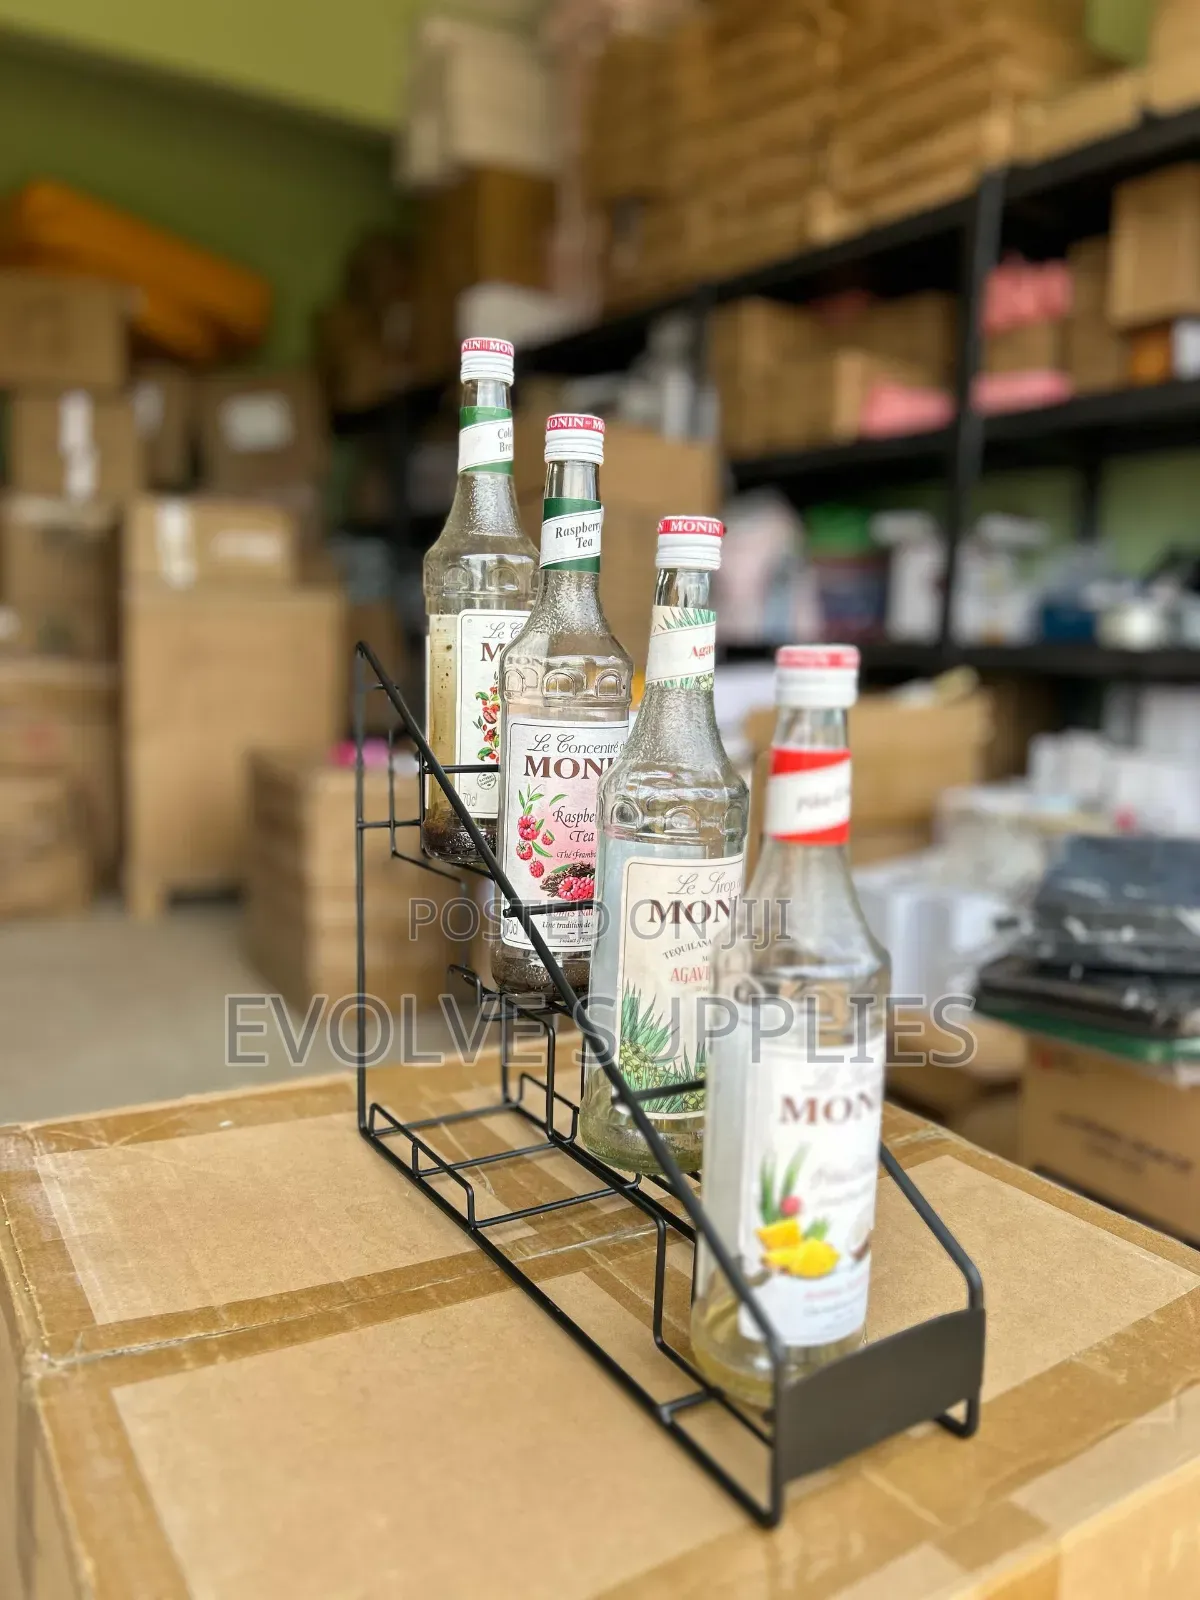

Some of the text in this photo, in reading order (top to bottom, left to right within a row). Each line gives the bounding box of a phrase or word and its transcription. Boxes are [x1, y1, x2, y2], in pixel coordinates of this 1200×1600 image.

[670, 521, 721, 534] MONIN
[576, 537, 593, 549] Tea
[482, 622, 505, 640] Le
[527, 733, 551, 753] Le
[556, 733, 619, 754] Concentré
[569, 830, 595, 843] Tea
[667, 873, 699, 895] Le
[701, 871, 736, 898] Sirop
